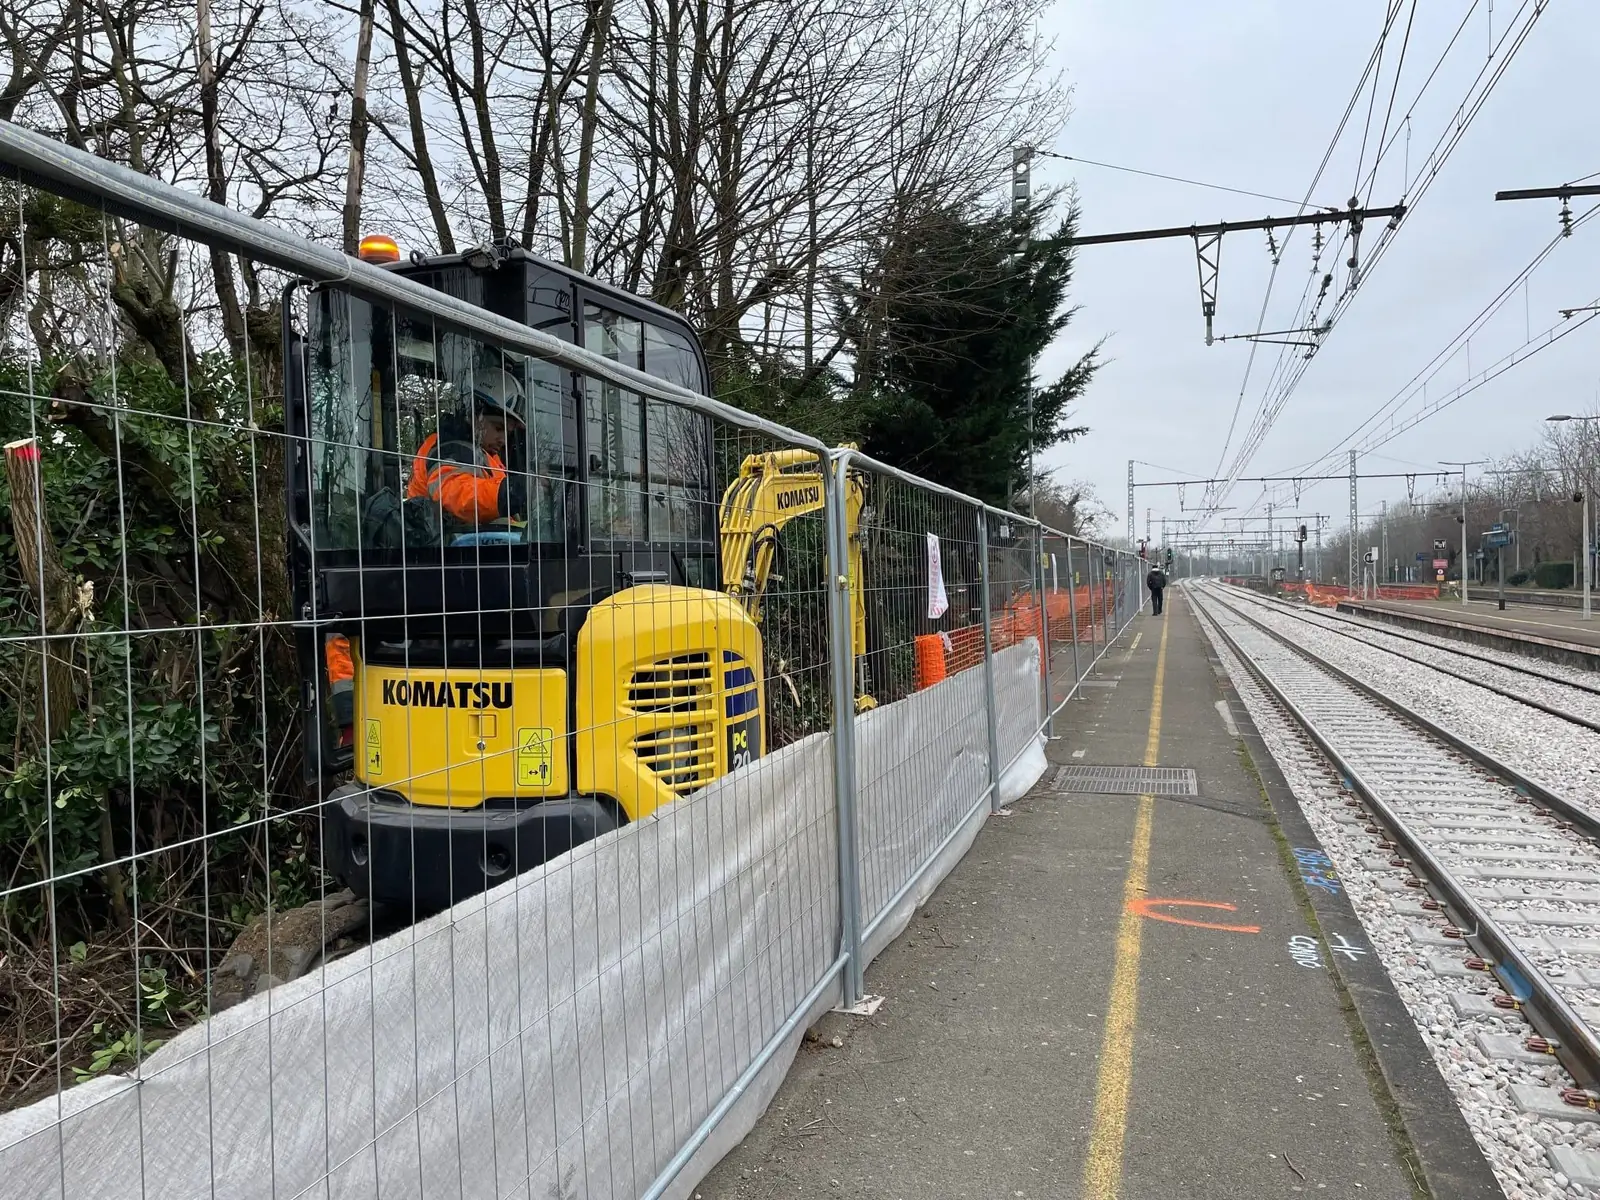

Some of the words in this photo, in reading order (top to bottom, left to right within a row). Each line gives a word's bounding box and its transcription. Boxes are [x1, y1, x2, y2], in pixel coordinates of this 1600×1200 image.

[777, 486, 819, 510] KOMATSU
[383, 679, 513, 709] KOMATSU
[732, 729, 747, 751] PC
